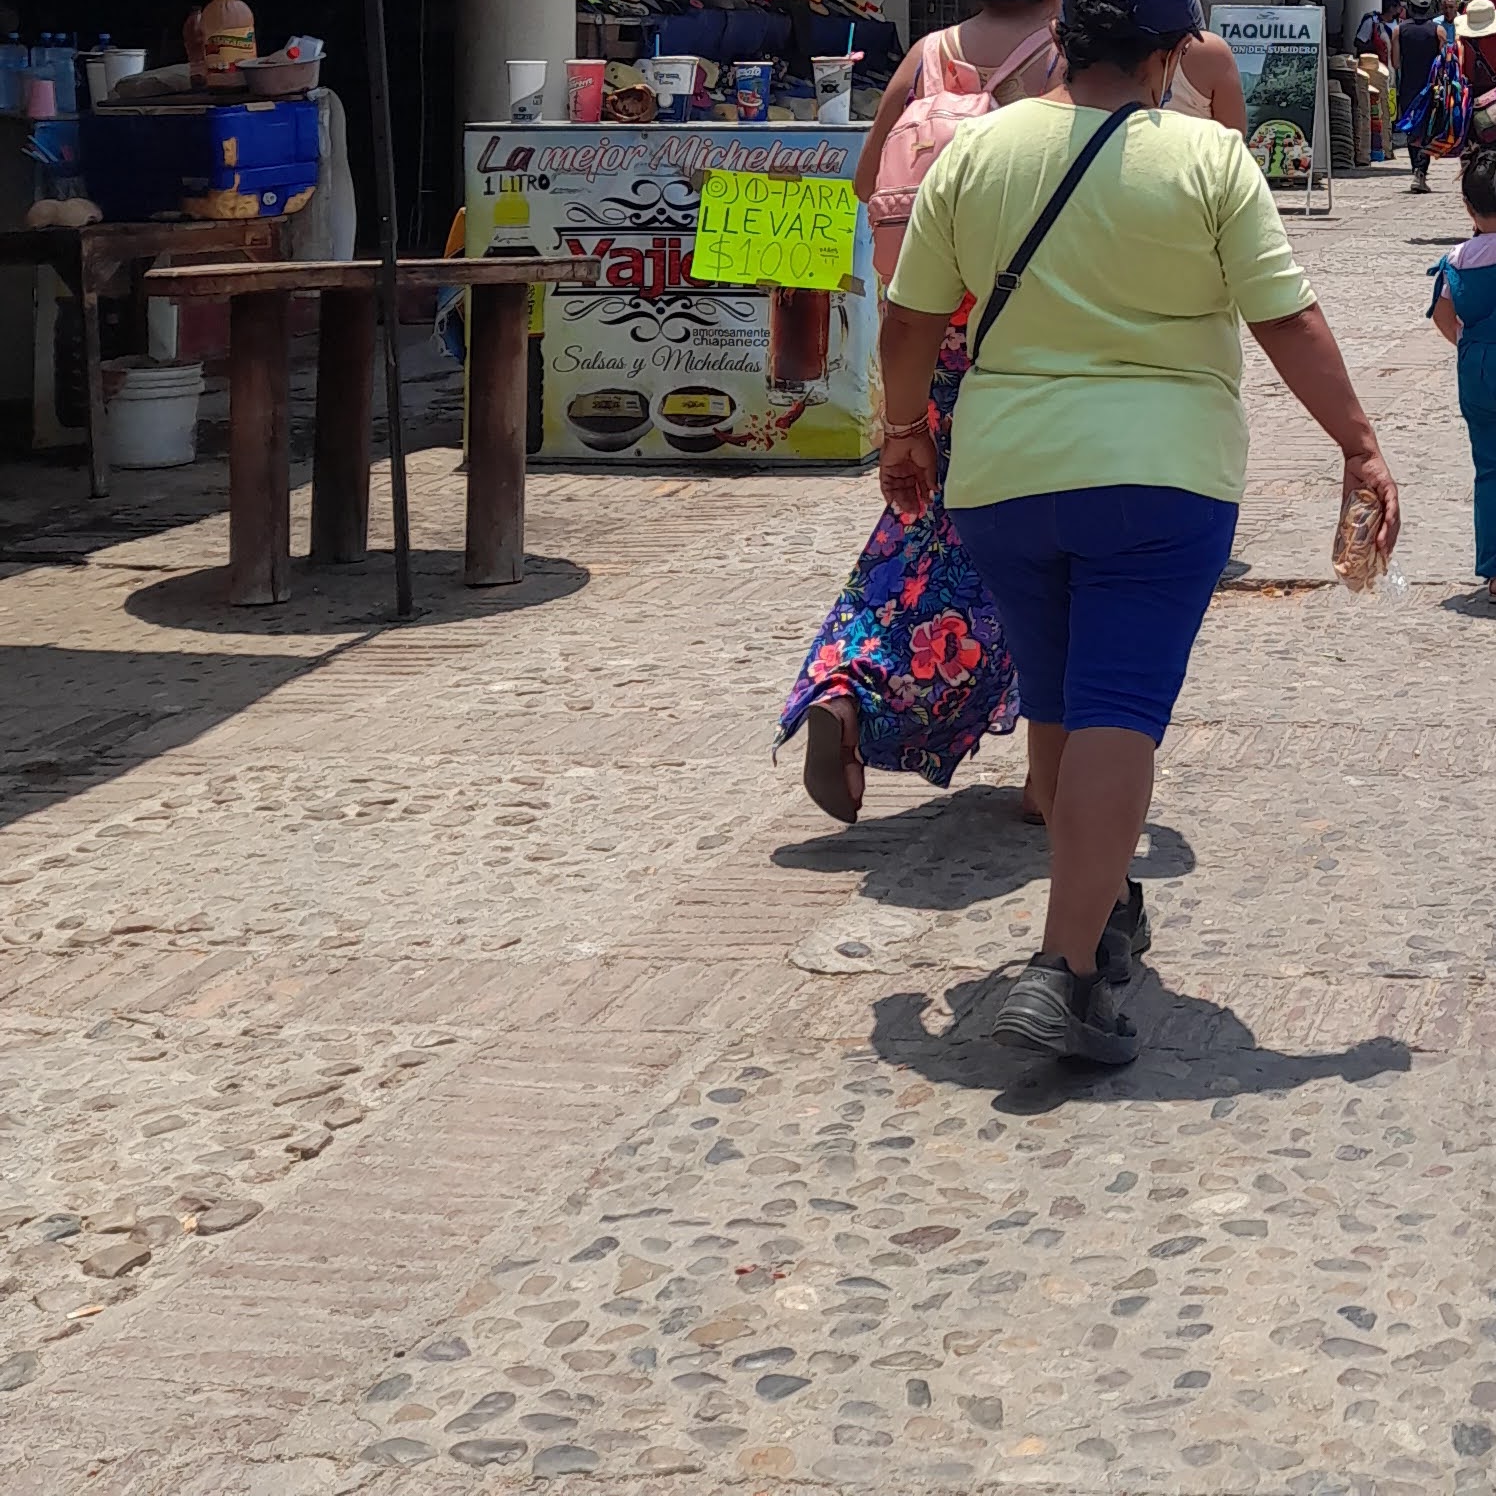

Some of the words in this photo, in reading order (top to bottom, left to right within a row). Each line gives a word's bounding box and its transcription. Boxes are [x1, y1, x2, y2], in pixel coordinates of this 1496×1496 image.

[1220, 23, 1311, 40] TAQUILLA
[1248, 45, 1266, 54] DEL
[1267, 45, 1318, 55] SUMIDERO
[477, 135, 536, 173] La
[538, 137, 648, 184] mejor
[650, 135, 848, 179] Michelada
[483, 176, 495, 195] 1
[499, 173, 551, 193] LITRO
[702, 206, 838, 242] LLEVAR
[564, 237, 716, 299] Yaji
[692, 327, 771, 339] amorosamente
[692, 336, 770, 349] chiapaneco
[552, 345, 626, 373] Salsas
[626, 356, 647, 379] y
[651, 345, 763, 373] Micheladas
